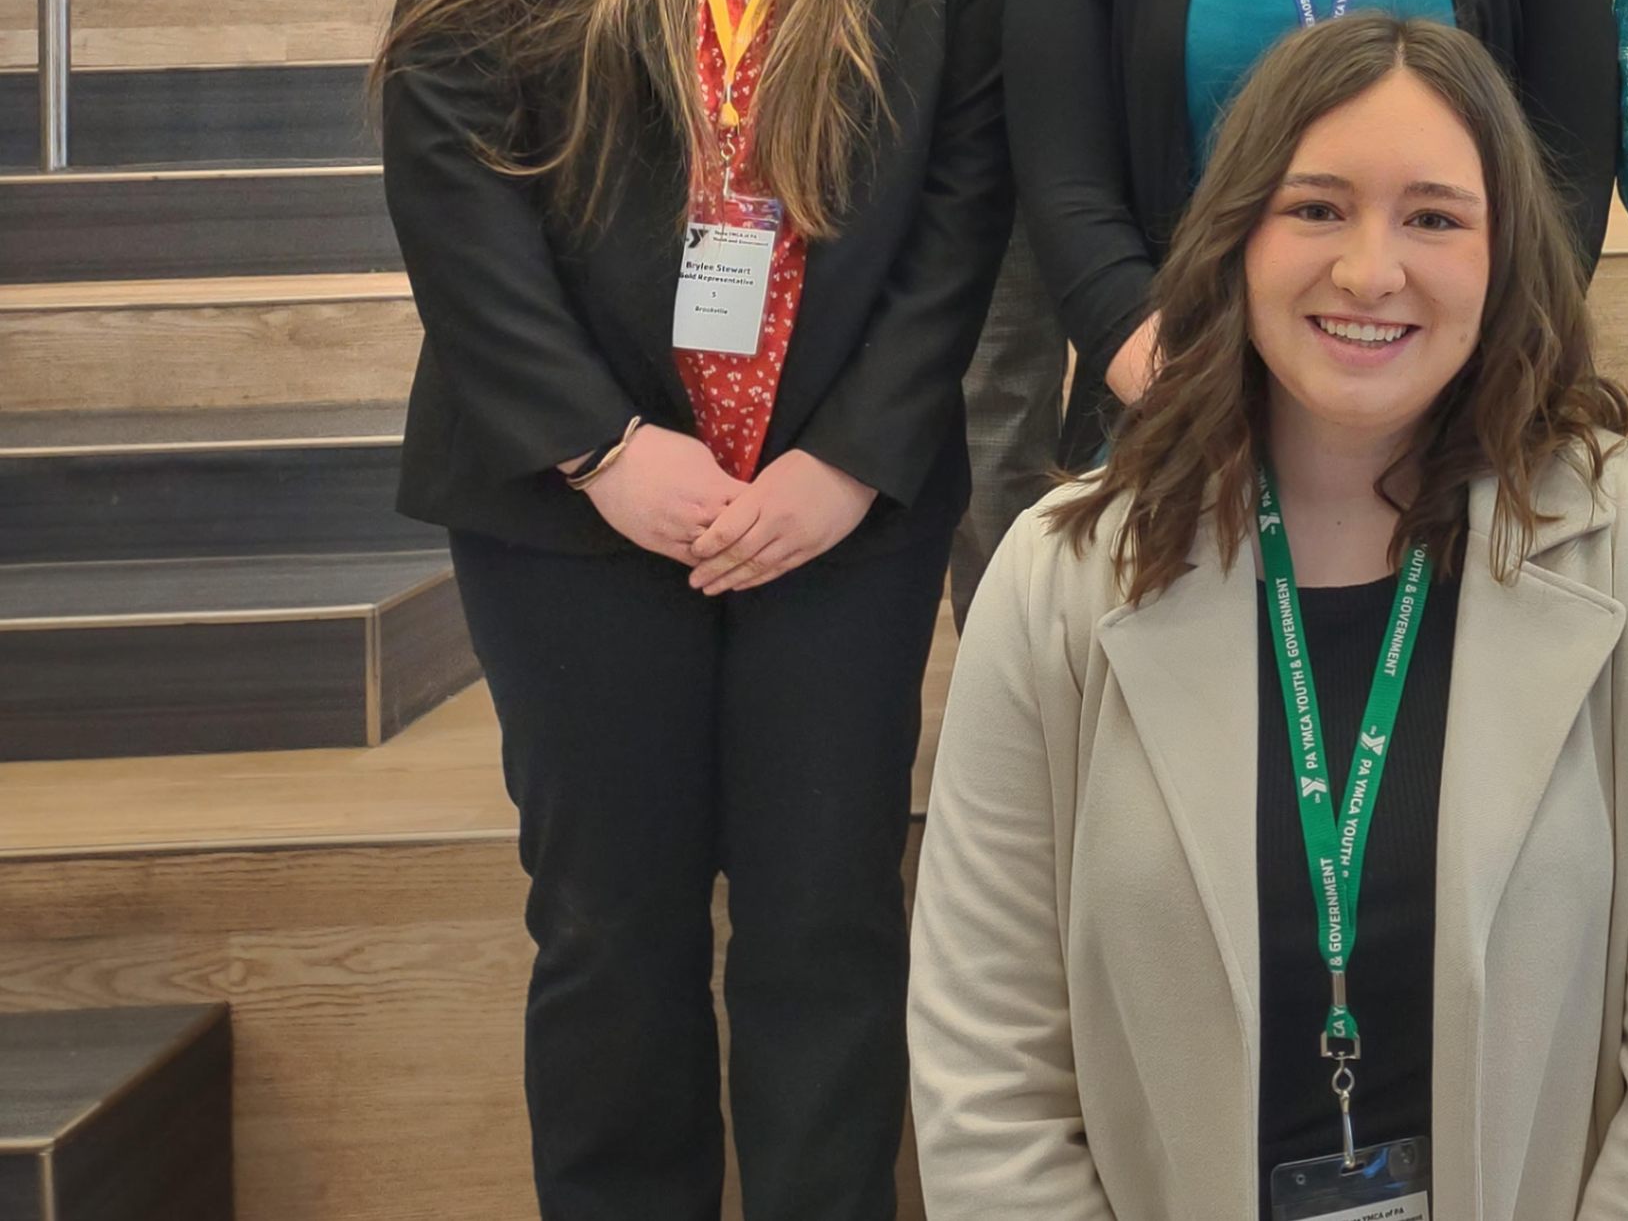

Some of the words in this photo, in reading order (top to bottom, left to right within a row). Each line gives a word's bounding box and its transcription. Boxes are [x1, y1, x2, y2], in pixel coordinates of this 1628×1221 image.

[686, 261, 714, 271] Brylee
[715, 264, 751, 275] Stewart
[697, 273, 754, 286] Representative
[1262, 490, 1272, 508] PA
[1405, 584, 1417, 594] &
[1275, 577, 1300, 658] GOVERNMENT
[1384, 596, 1414, 677] GOVERNMENT
[1290, 659, 1302, 669] &
[1293, 670, 1310, 714] YOUTH
[1299, 715, 1318, 751] YMCA
[1306, 751, 1319, 770] PA
[1358, 758, 1373, 776] PA
[1348, 779, 1368, 815] YMCA
[1340, 818, 1359, 866] YOUTH
[1320, 858, 1342, 952] GOVERNMENT
[1330, 955, 1343, 966] &
